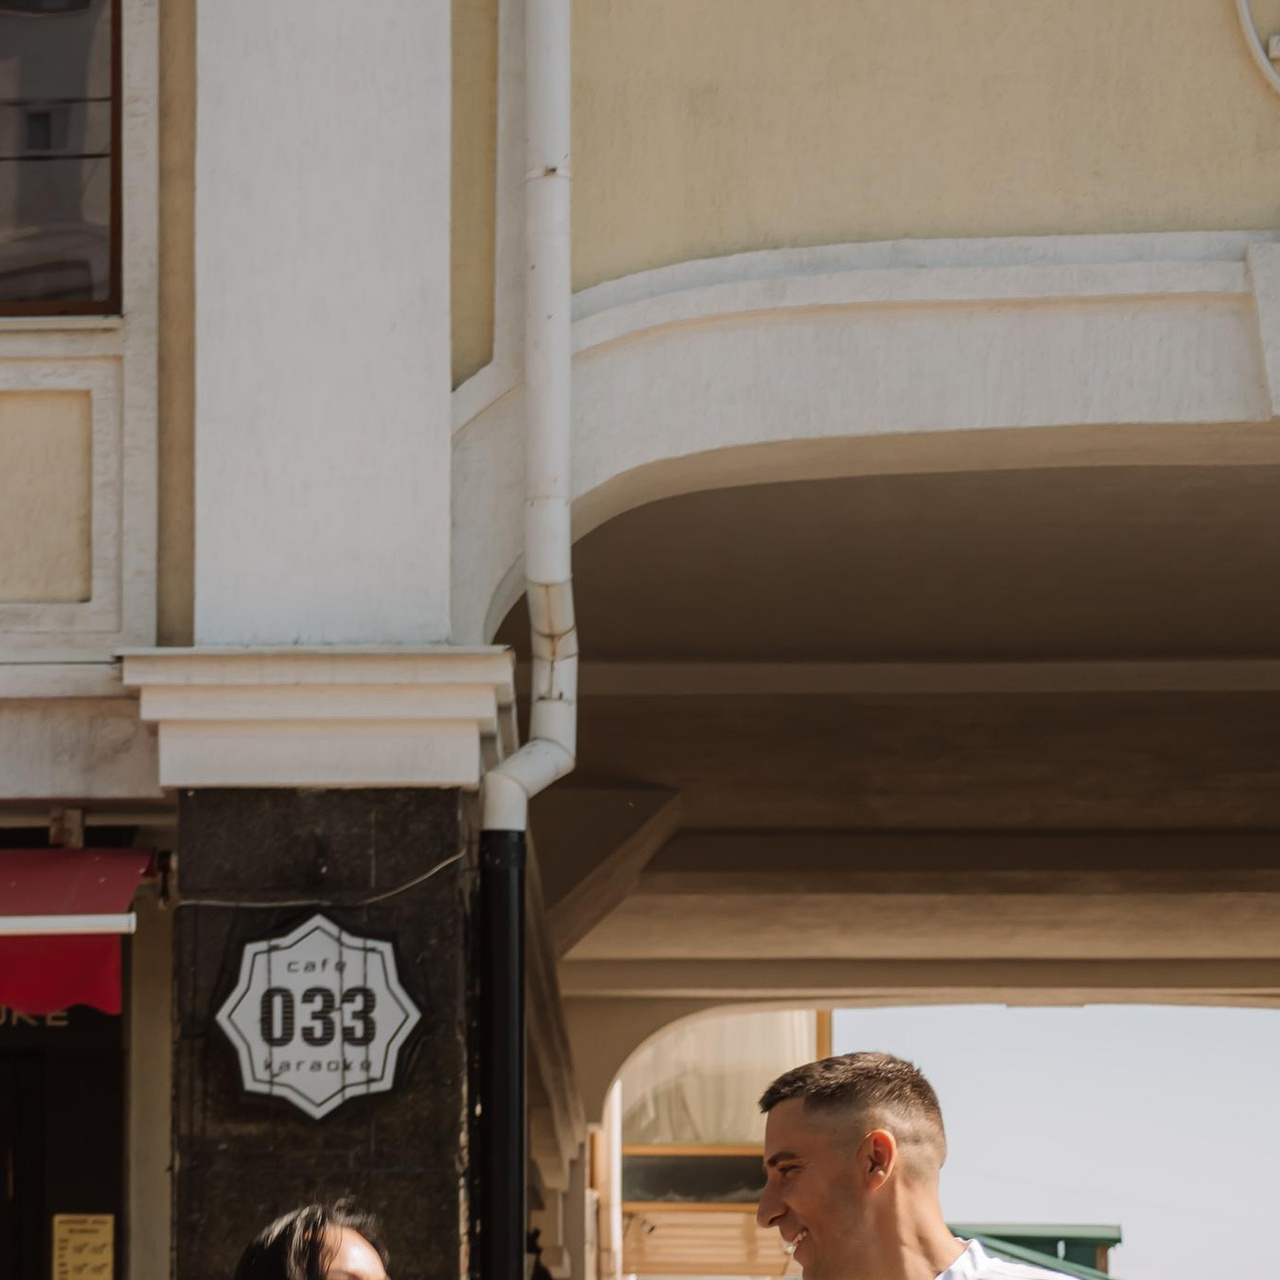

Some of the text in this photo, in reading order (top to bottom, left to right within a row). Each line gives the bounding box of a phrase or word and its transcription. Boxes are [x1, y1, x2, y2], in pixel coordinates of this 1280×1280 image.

[286, 957, 347, 973] cafe
[260, 986, 377, 1047] 033
[263, 1058, 372, 1074] karaoke
